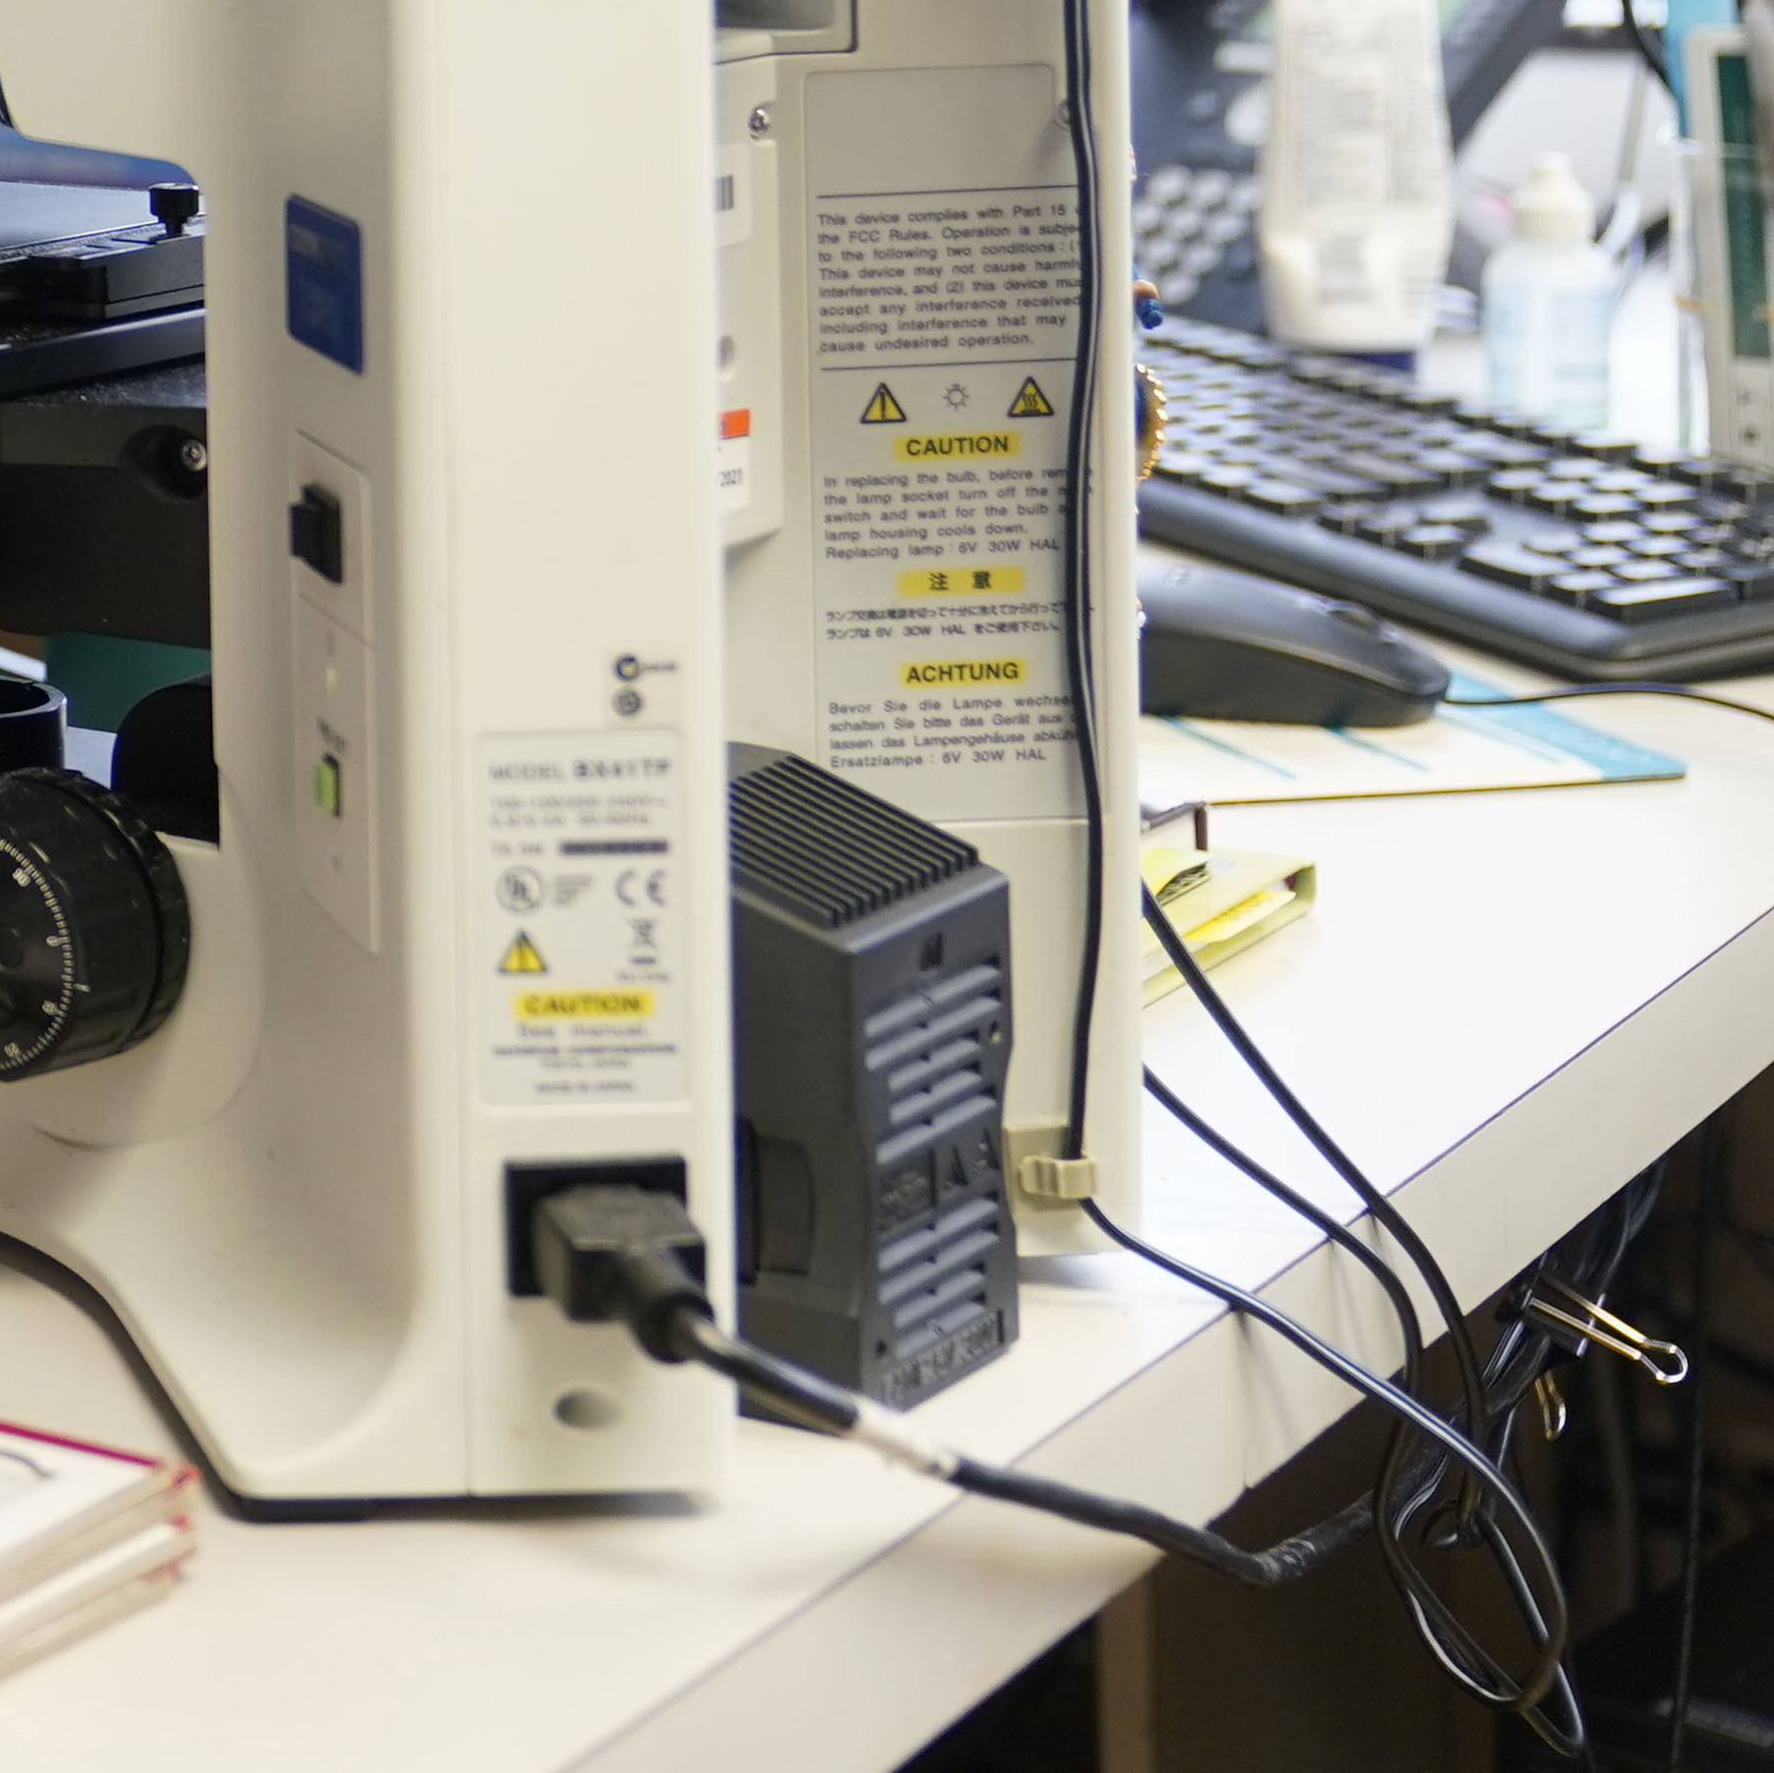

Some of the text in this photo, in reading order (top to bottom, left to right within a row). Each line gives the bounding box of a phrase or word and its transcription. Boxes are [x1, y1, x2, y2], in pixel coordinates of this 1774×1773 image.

[818, 204, 1065, 226] This device complies with Part 15
[818, 232, 839, 244] the
[849, 230, 880, 243] FCC
[889, 229, 932, 242] Rules.
[942, 226, 1010, 242] Operation
[1020, 224, 1030, 236] is
[818, 250, 832, 263] to
[841, 248, 864, 262] the
[874, 246, 937, 261] following
[946, 245, 972, 257] two
[819, 267, 849, 281] This
[858, 266, 904, 279] device
[914, 263, 942, 278] may
[952, 263, 974, 275] not
[983, 262, 1025, 274] cause
[913, 281, 937, 295] and
[972, 279, 996, 291] this
[1005, 277, 1047, 291] device
[819, 301, 869, 318] accept
[879, 302, 906, 316] any
[915, 297, 1006, 312] interference
[820, 314, 1065, 335] including interference that may
[820, 341, 865, 353] cause
[874, 336, 948, 350] undesired
[907, 435, 1009, 456] CAUTION
[824, 477, 836, 488] In
[846, 474, 908, 489] replacing
[917, 473, 939, 484] the
[989, 468, 1033, 482] before
[825, 494, 847, 506] the
[857, 492, 892, 506] lamp
[901, 489, 949, 503] socket
[958, 488, 987, 501] turn
[997, 486, 1016, 499] off
[1025, 485, 1048, 497] the
[825, 510, 871, 524] switch
[880, 508, 907, 521] and
[917, 507, 946, 520] wait
[956, 506, 975, 518] for
[985, 505, 1007, 517] the
[1017, 503, 1049, 515] bulb
[825, 529, 860, 543] lamp
[870, 526, 927, 541] housing
[937, 525, 975, 537] cools
[826, 546, 899, 562] Replacing
[958, 541, 977, 554] 6V
[989, 539, 1020, 553] 30W
[1030, 539, 1060, 551] HAL
[907, 662, 1019, 684] ACHTUNG
[829, 701, 872, 715] Bevor
[884, 700, 907, 712] Sie
[919, 699, 941, 711] die
[953, 697, 1002, 712] Lampe
[829, 713, 1062, 733] schalten Sie bitte das Gerät aus
[830, 737, 873, 750] lassen
[882, 736, 906, 747] das
[914, 731, 1025, 750] Lampengehäuse
[942, 752, 960, 765] 6V
[972, 751, 1005, 764] 30W
[1016, 750, 1046, 762] HAL
[523, 993, 643, 1015] CAUTION
